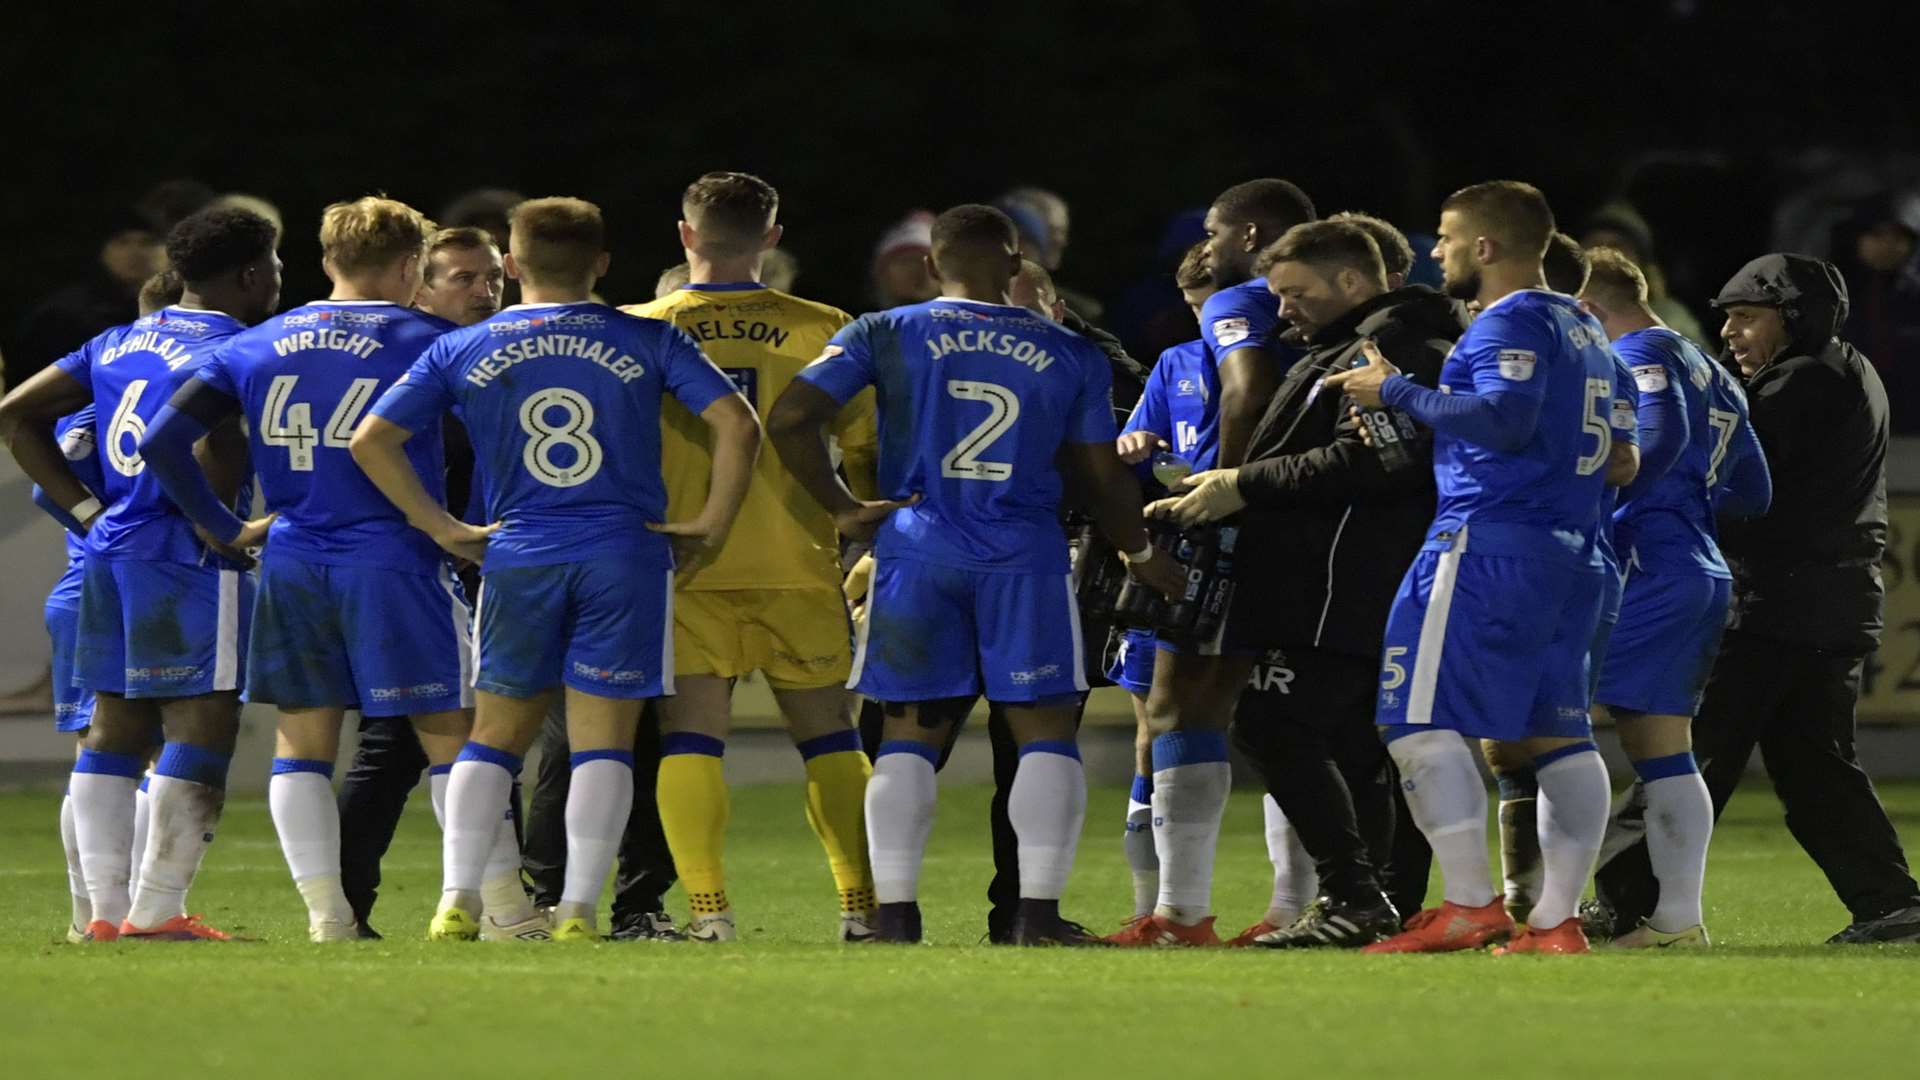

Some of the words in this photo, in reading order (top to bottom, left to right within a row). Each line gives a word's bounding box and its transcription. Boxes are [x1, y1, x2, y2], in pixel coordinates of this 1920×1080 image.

[100, 331, 193, 372] OSHILAJA
[273, 328, 385, 359] WRIGHT
[466, 335, 645, 388] HESSENTHALER
[926, 330, 1055, 373] JACKSON
[106, 380, 149, 477] 6
[519, 388, 603, 488] 8
[941, 380, 1020, 481] 2
[1576, 378, 1611, 476] 5
[1706, 407, 1739, 488] 7
[1382, 646, 1408, 690] 5
